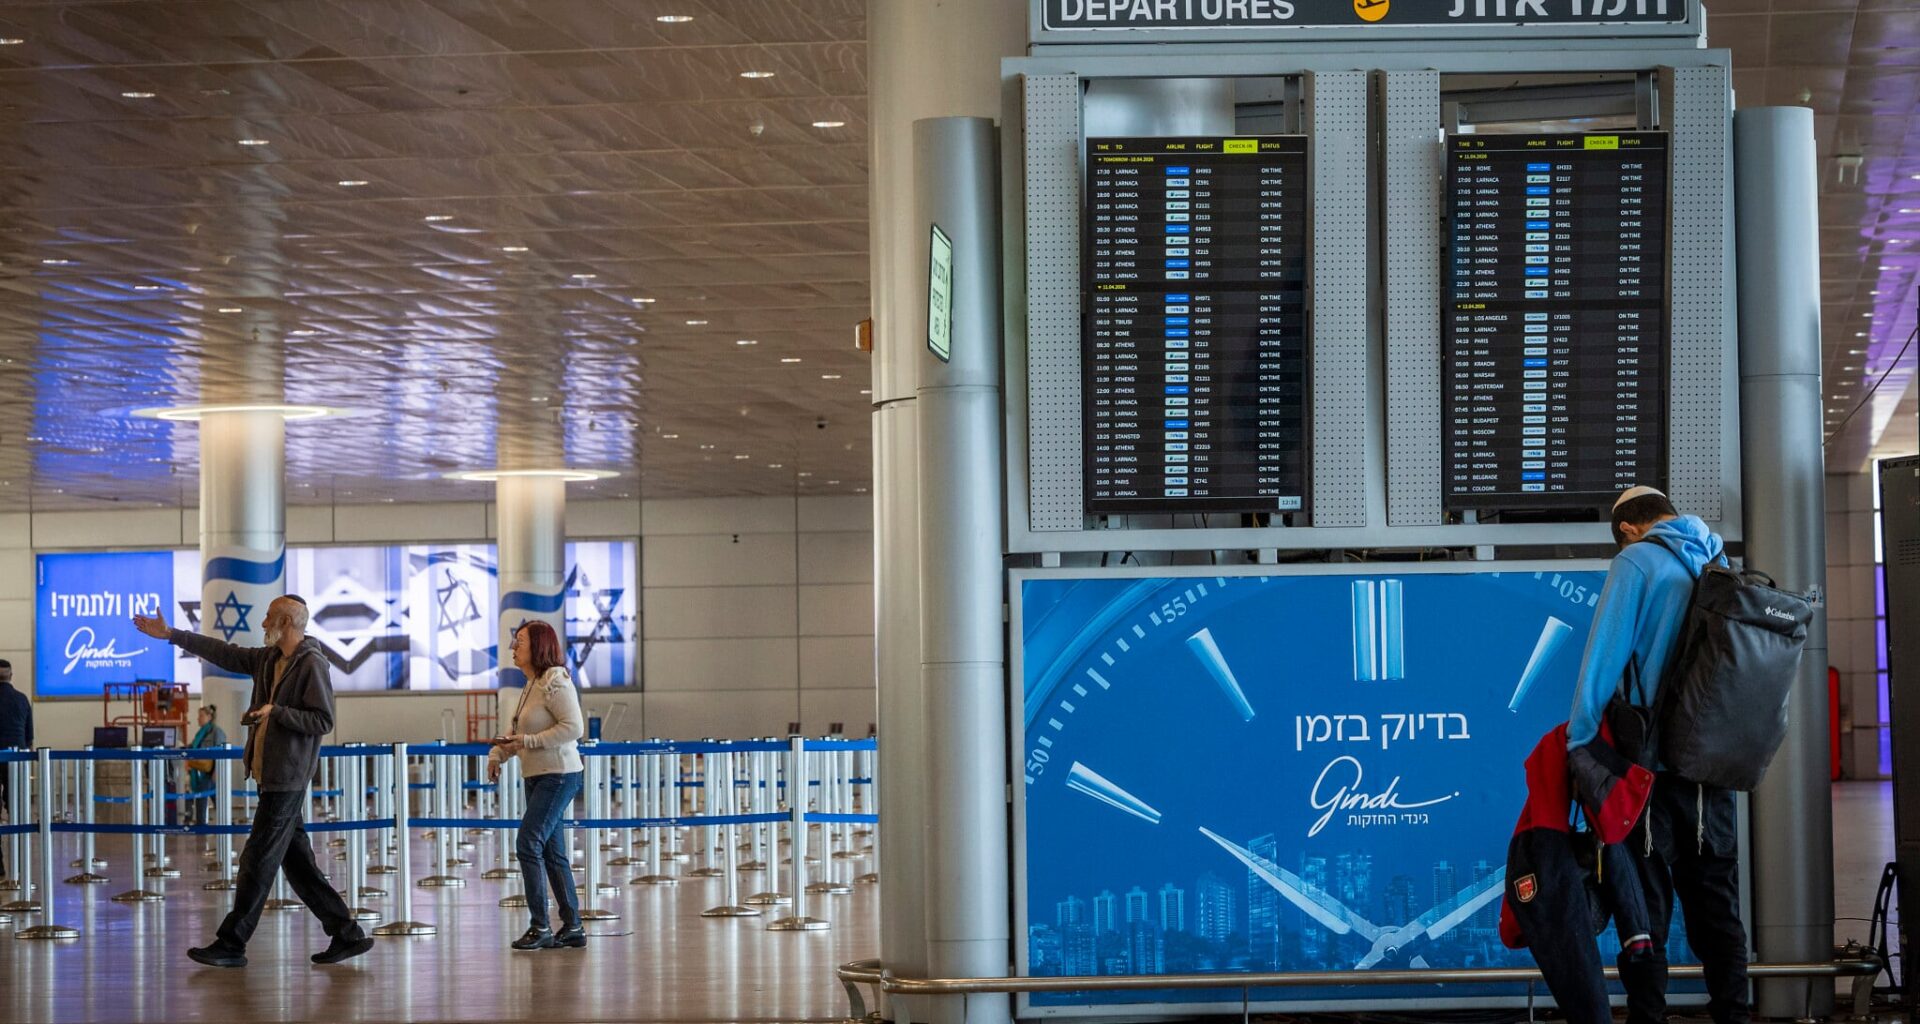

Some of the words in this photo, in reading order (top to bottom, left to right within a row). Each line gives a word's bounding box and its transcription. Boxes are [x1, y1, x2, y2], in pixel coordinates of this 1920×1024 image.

[1061, 0, 1295, 21] DEPARTURES
[1448, 0, 1668, 17] המראות
[51, 590, 121, 617] ולתמיד!
[1560, 580, 1587, 604] 05
[128, 592, 160, 620] כאן
[1161, 596, 1187, 623] 55
[1770, 607, 1795, 621] Columbia
[1295, 714, 1371, 751] בזמן
[1381, 712, 1471, 750] בדיוק
[1027, 748, 1050, 776] 50
[1347, 813, 1397, 828] החזקות
[1401, 813, 1429, 824] גינדי
